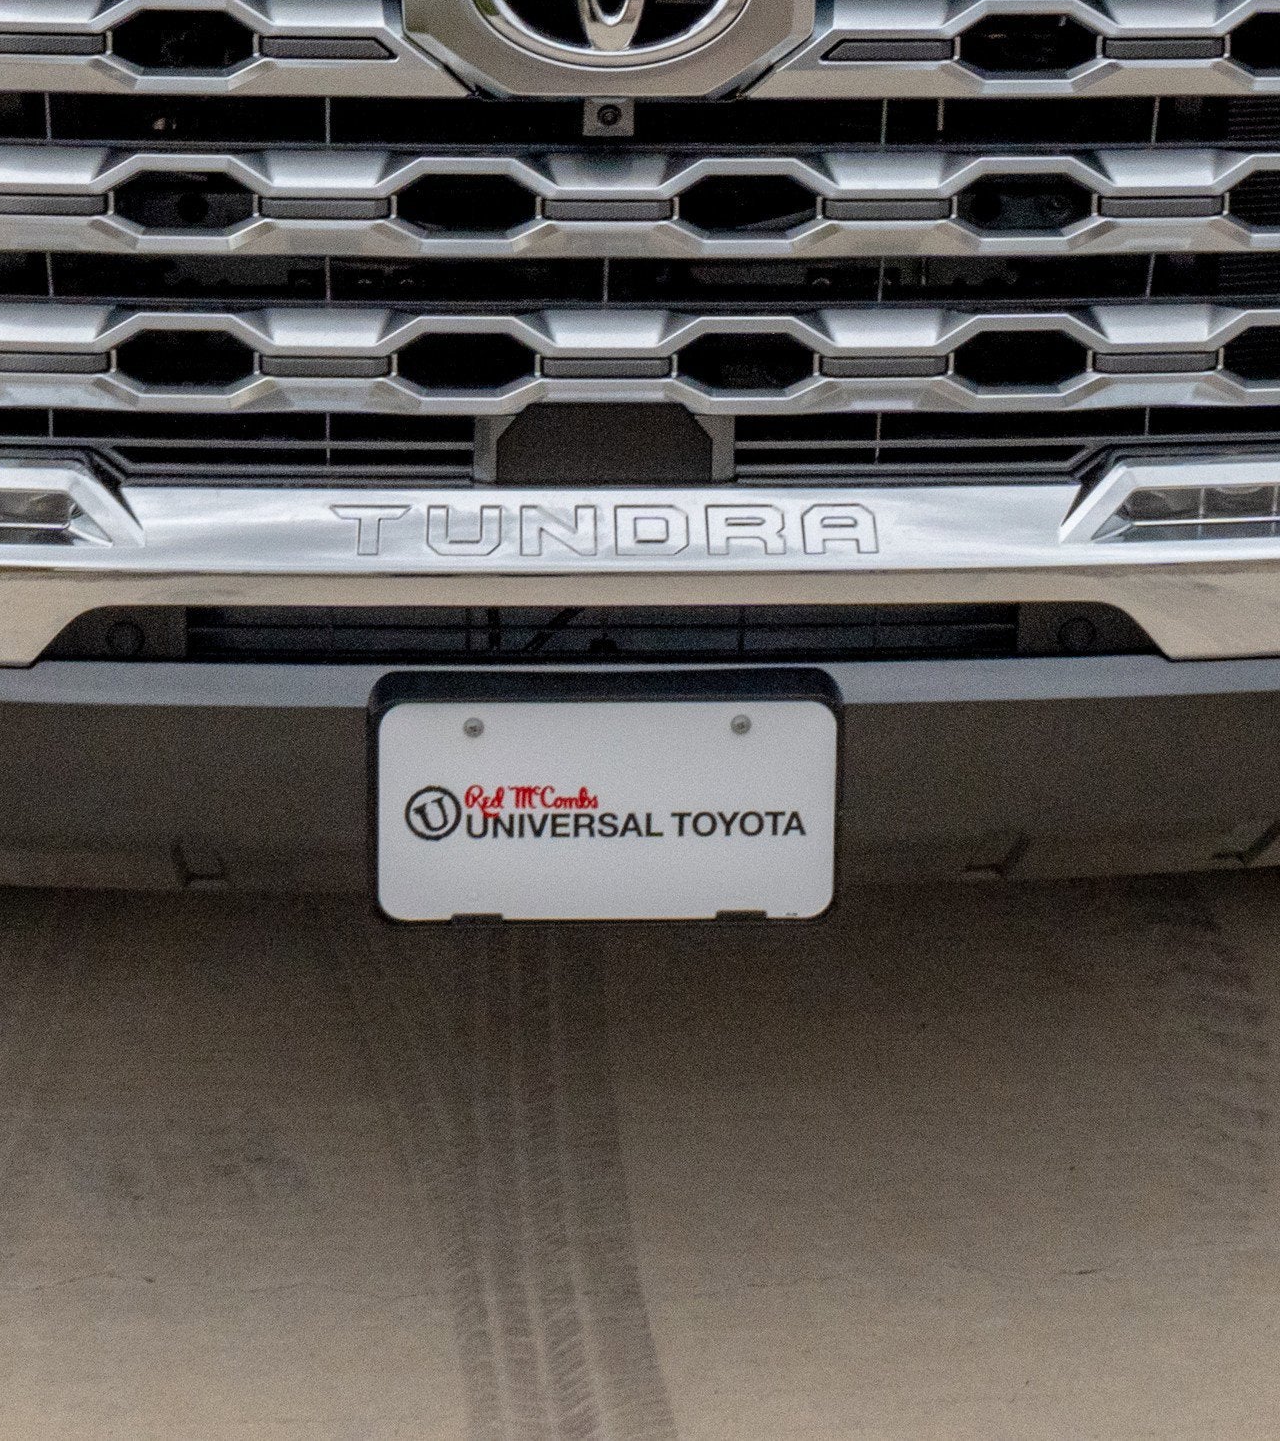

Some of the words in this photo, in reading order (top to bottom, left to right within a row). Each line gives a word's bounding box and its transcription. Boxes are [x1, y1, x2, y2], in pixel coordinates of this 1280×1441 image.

[329, 503, 880, 557] TUNDRA
[464, 784, 505, 817] Red
[509, 785, 599, 809] McCombs
[465, 812, 664, 838] UNIVERSAL
[670, 810, 807, 837] TOYOTA
